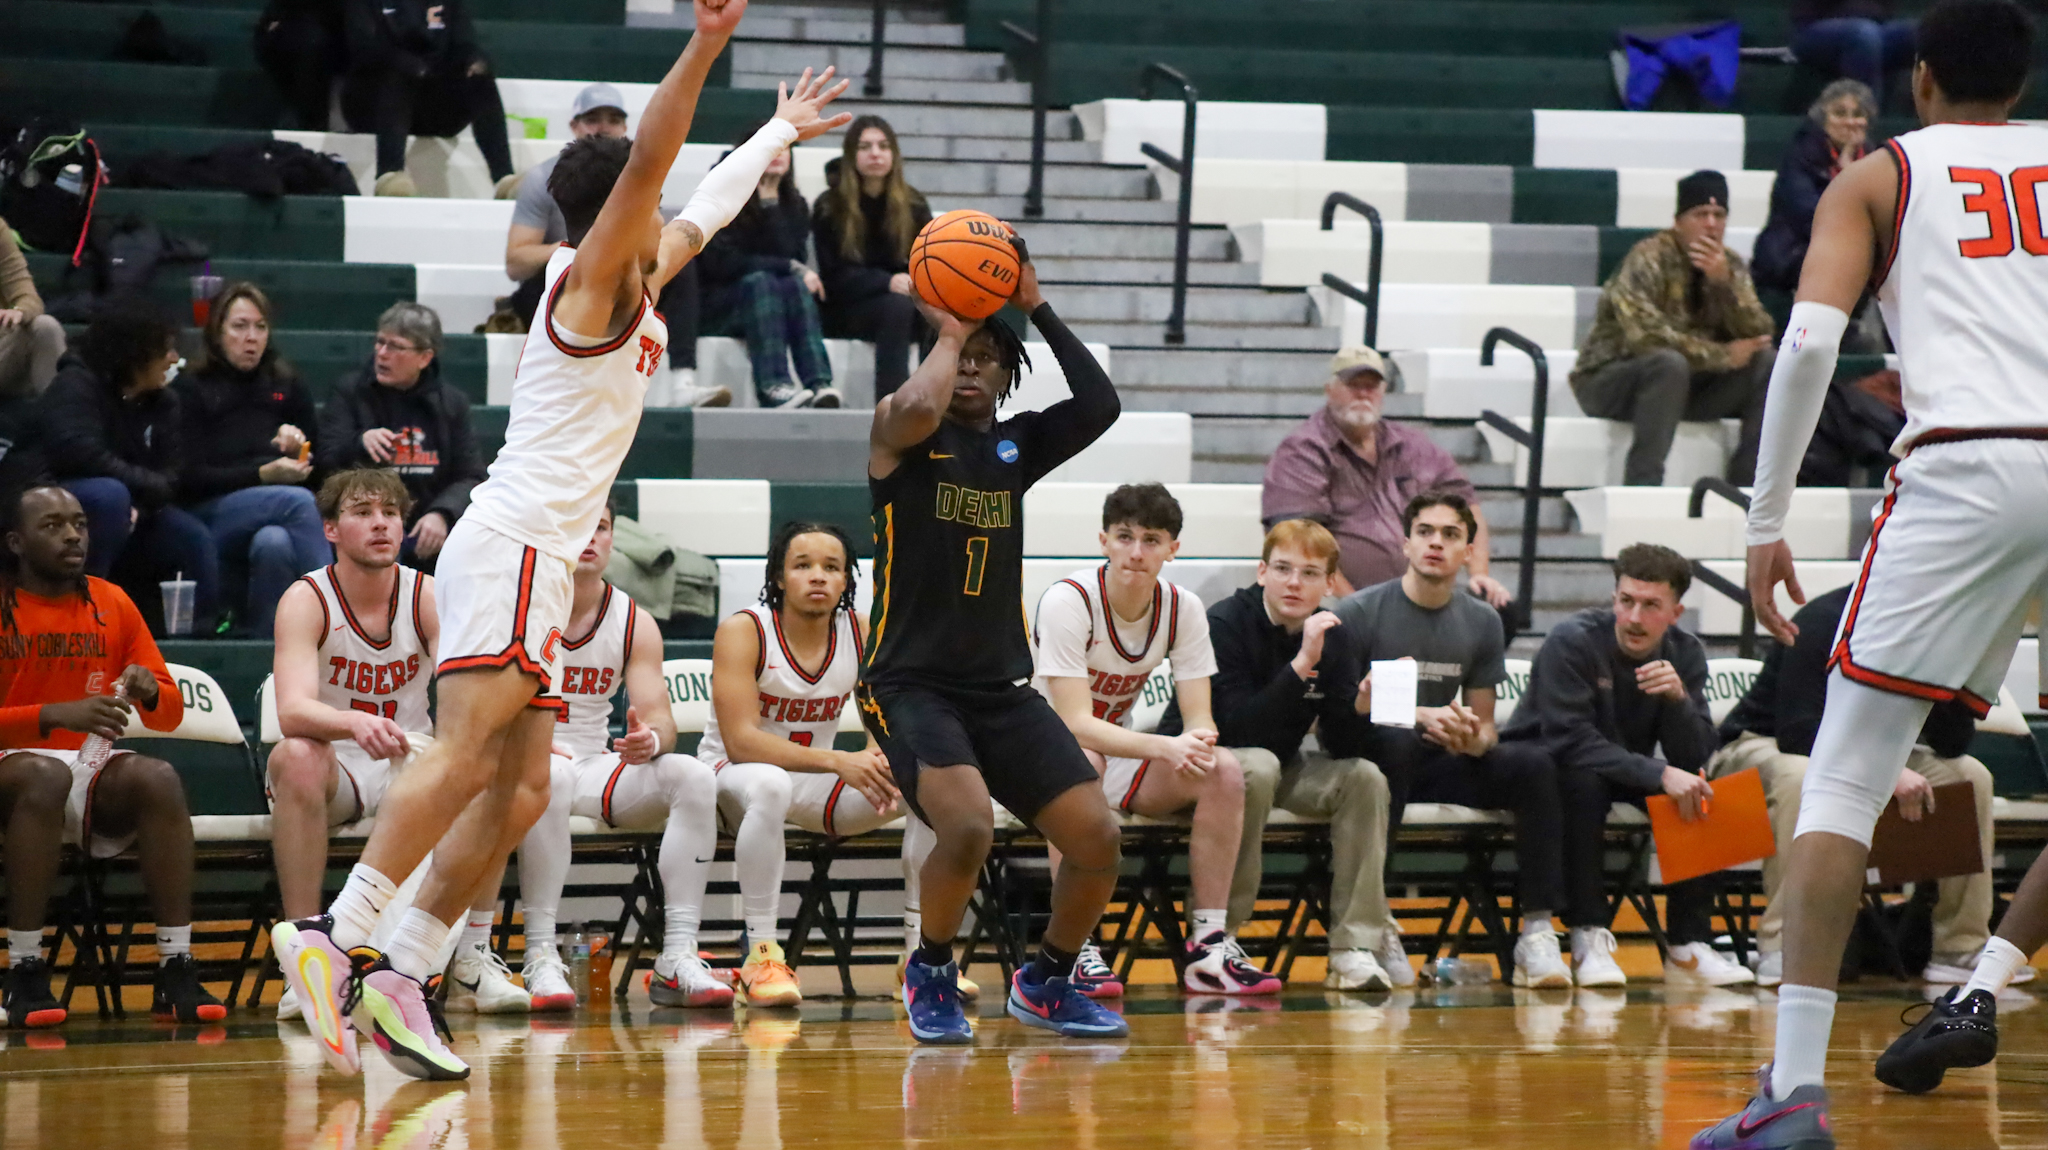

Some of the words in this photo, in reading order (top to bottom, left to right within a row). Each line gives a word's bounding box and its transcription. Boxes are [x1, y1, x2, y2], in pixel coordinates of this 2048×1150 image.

[1947, 164, 2048, 258] 30
[977, 259, 1014, 284] EVO
[964, 536, 989, 596] 1
[328, 653, 420, 695] TIGERS
